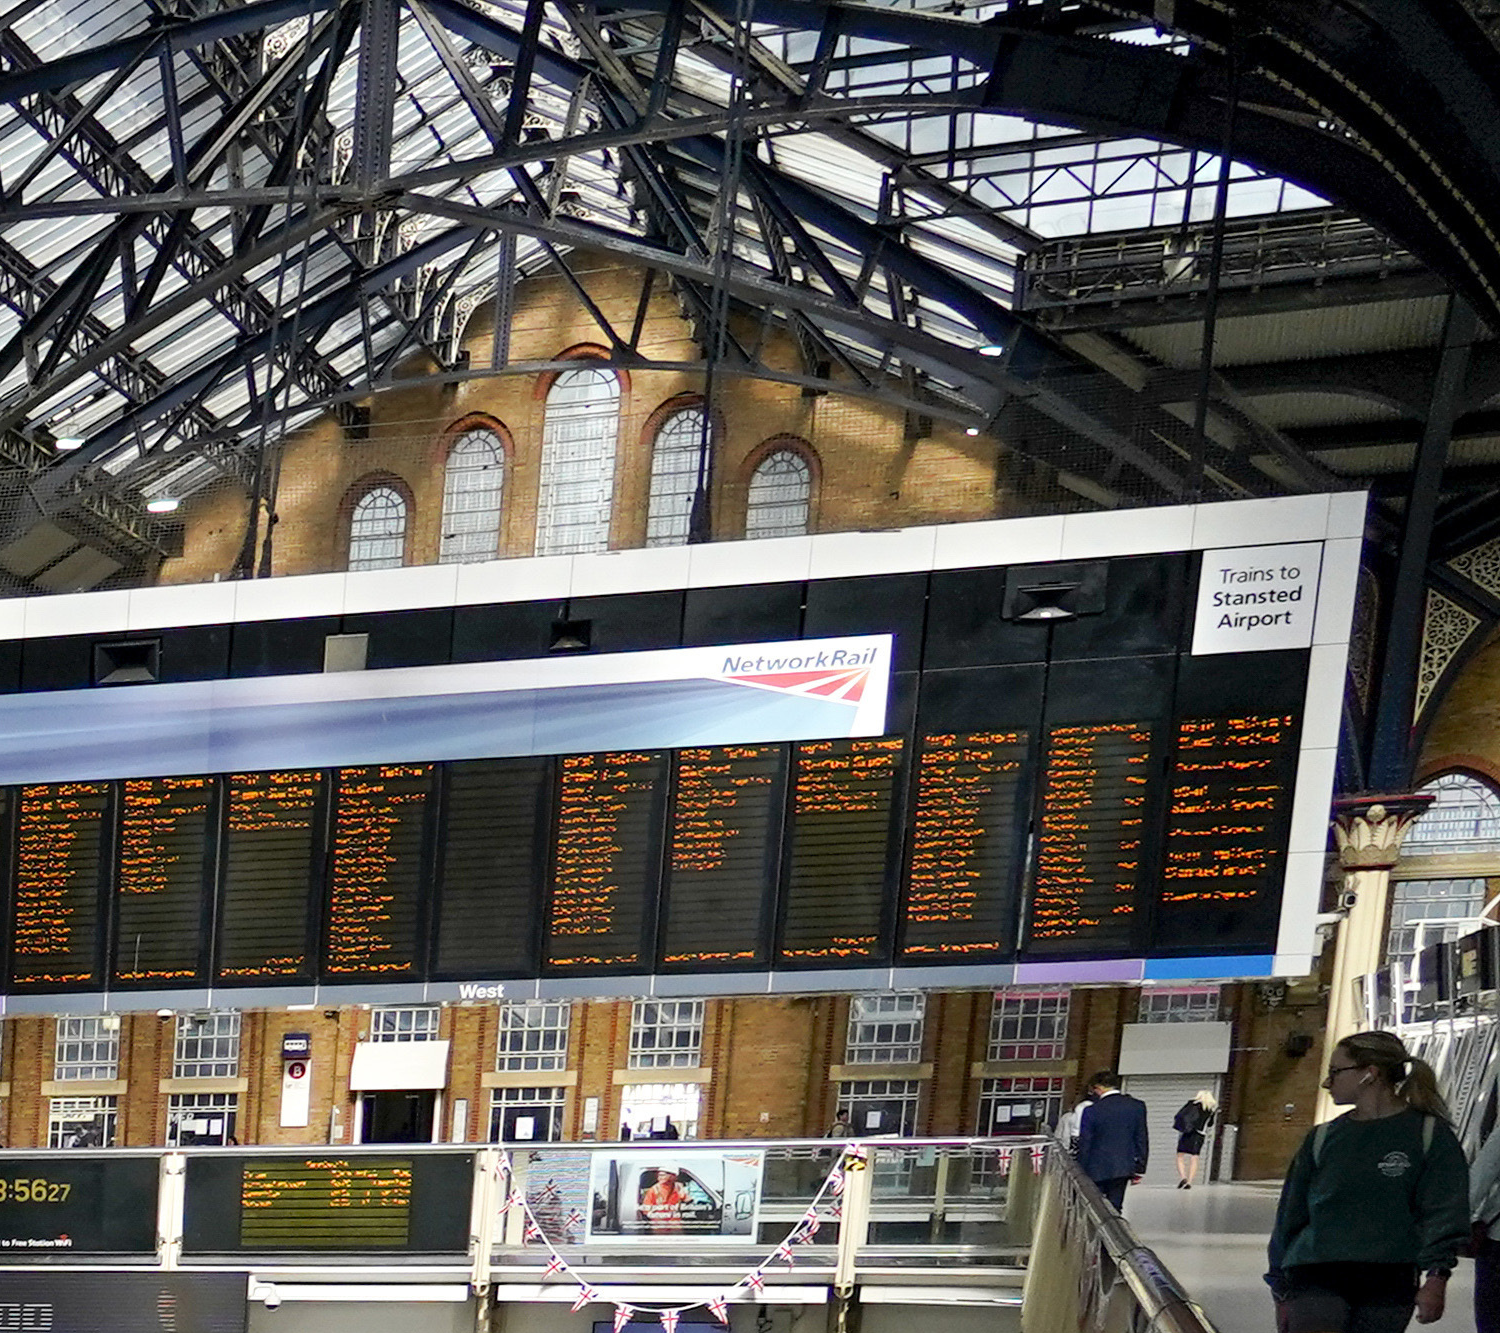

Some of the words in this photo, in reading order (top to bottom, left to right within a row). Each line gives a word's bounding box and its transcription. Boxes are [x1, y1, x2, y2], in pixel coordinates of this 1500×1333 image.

[1220, 566, 1274, 584] Trains
[1281, 566, 1300, 580] to
[1213, 585, 1303, 607] Stansted
[1217, 611, 1292, 631] Airport
[459, 983, 504, 998] West
